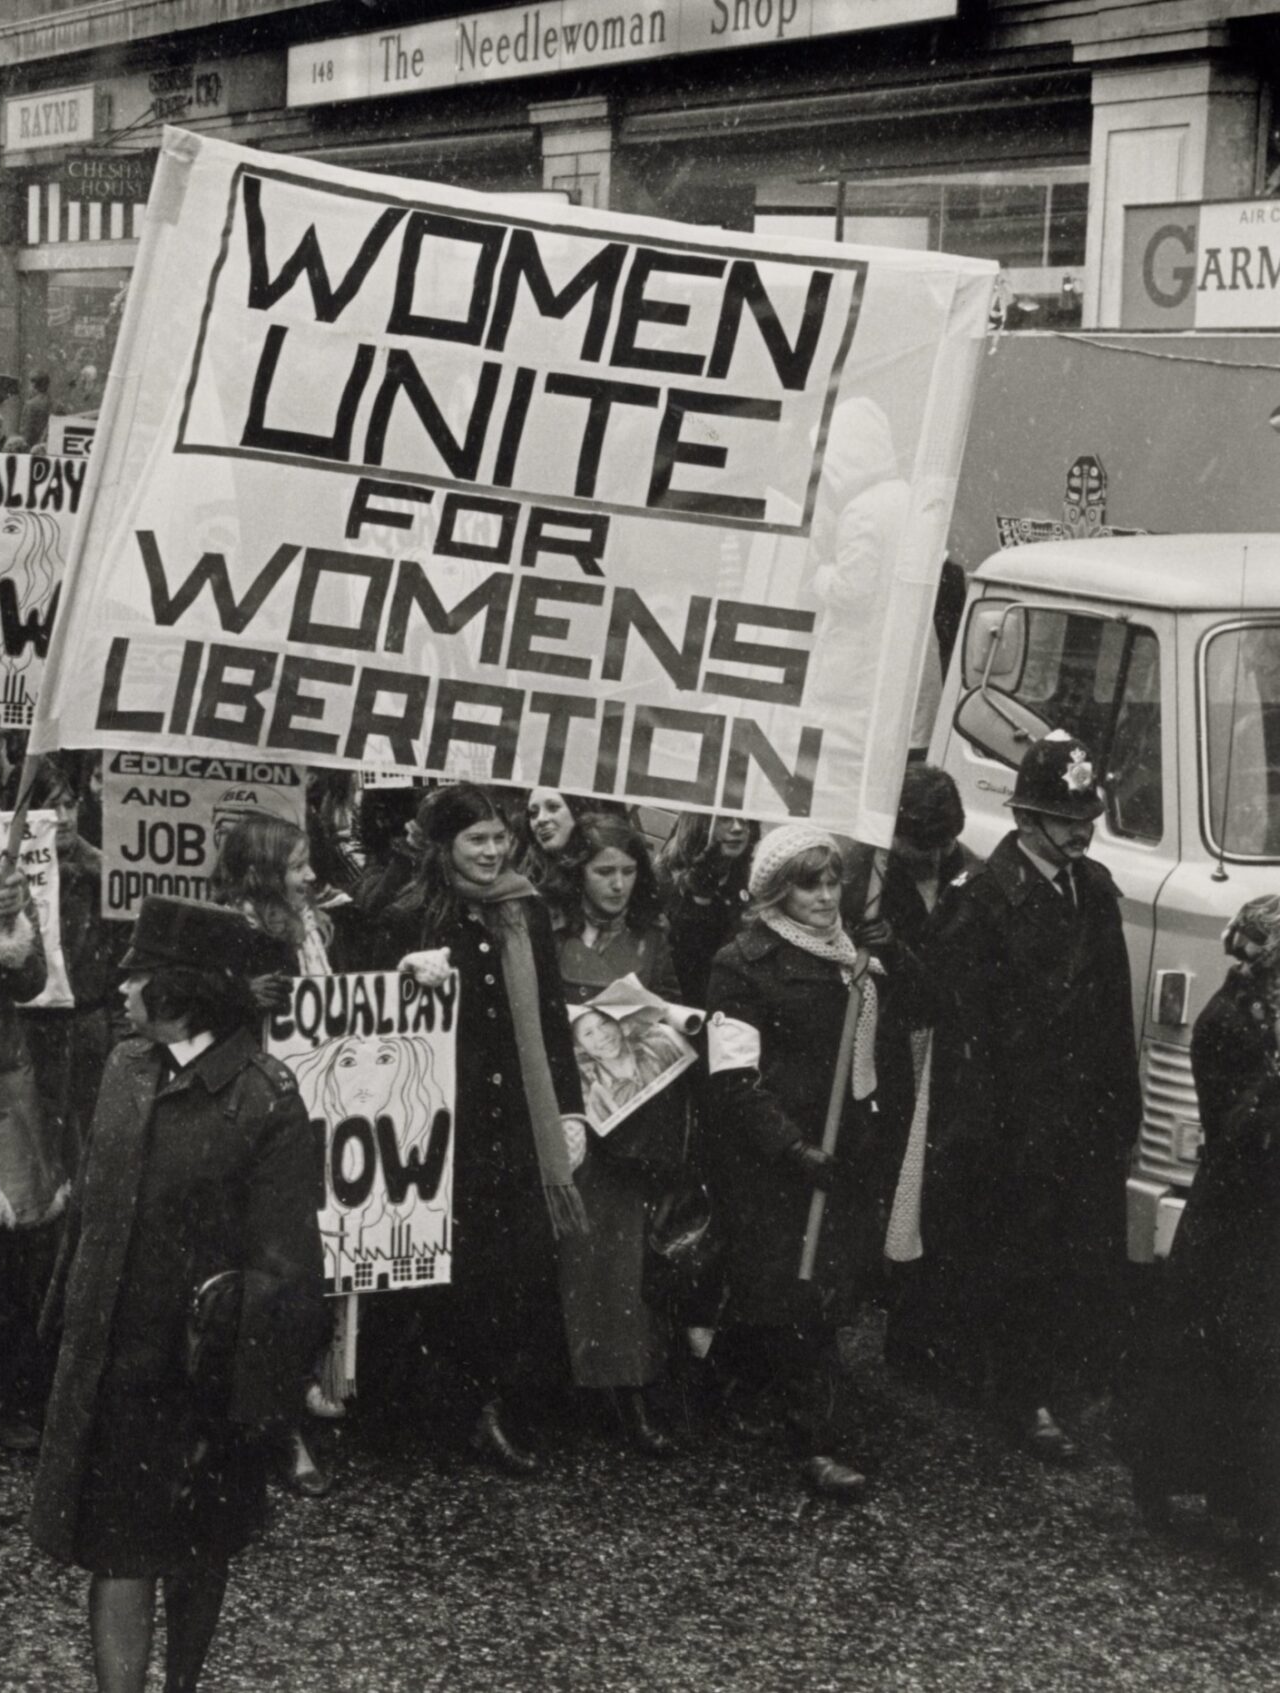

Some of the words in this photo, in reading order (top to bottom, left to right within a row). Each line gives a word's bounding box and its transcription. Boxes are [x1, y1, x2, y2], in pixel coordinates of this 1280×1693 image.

[312, 59, 333, 85] 148
[379, 34, 424, 83] The
[457, 7, 667, 72] Needlewoman
[20, 99, 79, 139] RAYNE
[68, 160, 147, 178] CHESHA
[1239, 208, 1266, 225] AIR
[241, 174, 834, 392] WOMEN
[241, 324, 783, 520] UNITE
[27, 455, 89, 514] PAY
[344, 476, 611, 577] FOR
[134, 529, 817, 706] WOMENS
[94, 636, 824, 817] LIBERATION
[120, 753, 292, 785] EDUCATION
[122, 787, 191, 808] AND
[223, 790, 258, 804] BEA
[121, 820, 206, 866] JOB
[320, 1110, 453, 1212] OW
